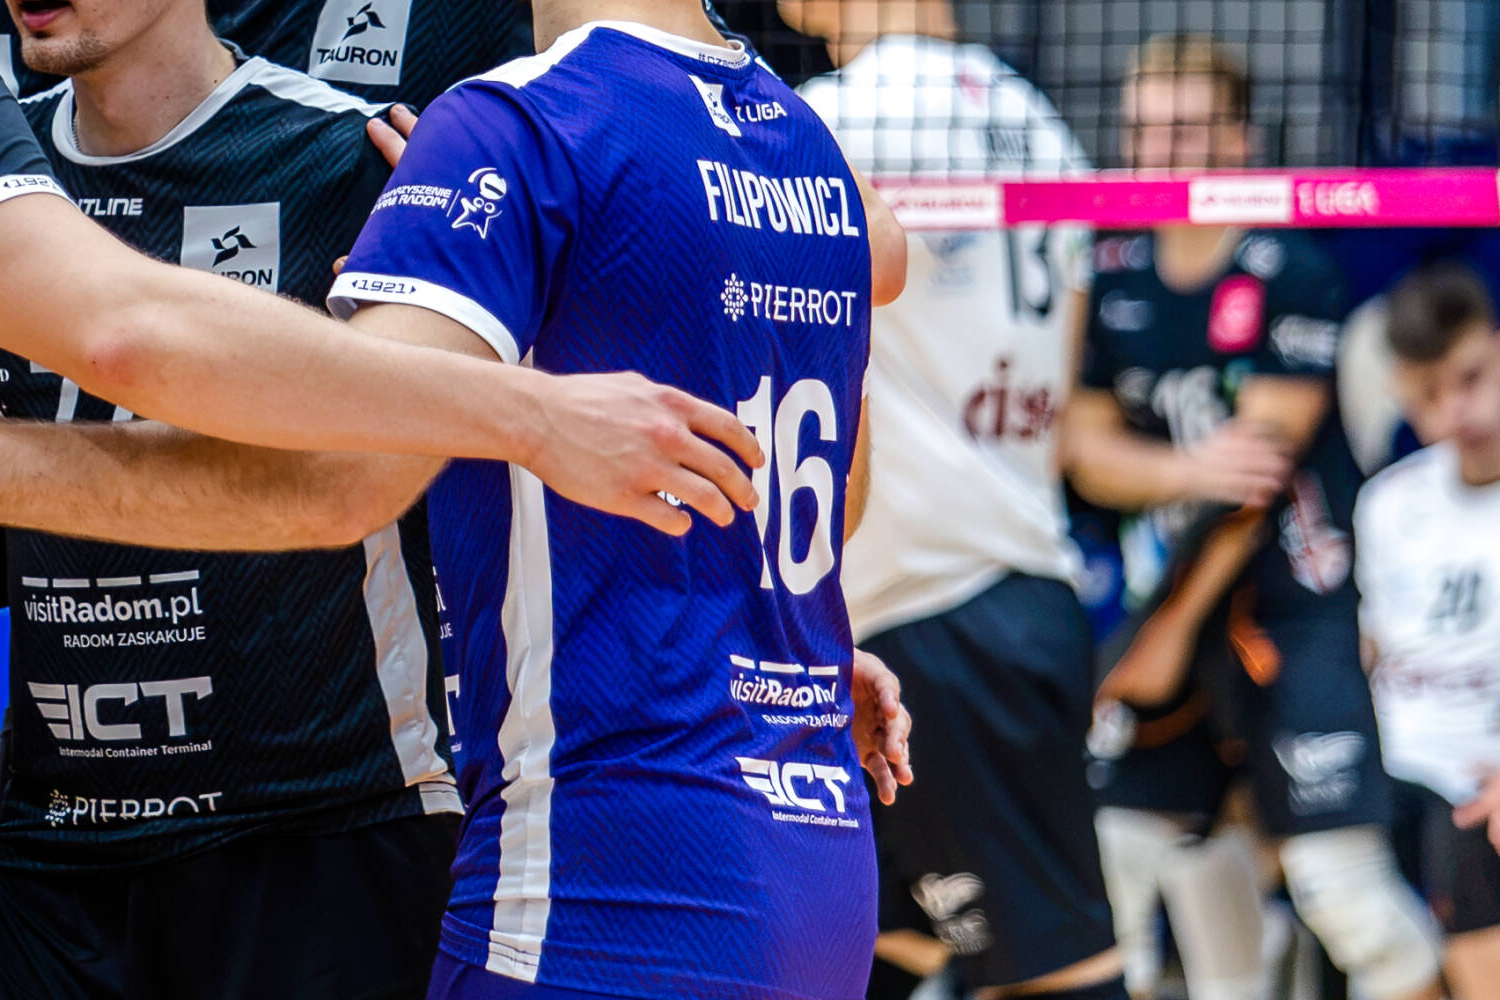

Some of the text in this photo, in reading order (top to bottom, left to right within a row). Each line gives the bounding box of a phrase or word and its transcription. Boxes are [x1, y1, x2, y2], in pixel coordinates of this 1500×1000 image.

[316, 46, 398, 67] TAURON
[745, 100, 788, 123] LIGA
[77, 198, 144, 216] TLINE
[397, 194, 449, 210] RADOM
[696, 159, 860, 237] FILIPOWICZ
[357, 279, 407, 295] 1921
[750, 281, 857, 327] PIERROT
[736, 376, 838, 596] 16
[24, 587, 203, 624] visitRadom.pl
[63, 627, 206, 648] RADOM ZASKAKUJE
[59, 740, 213, 758] Intermodal Container Terminal
